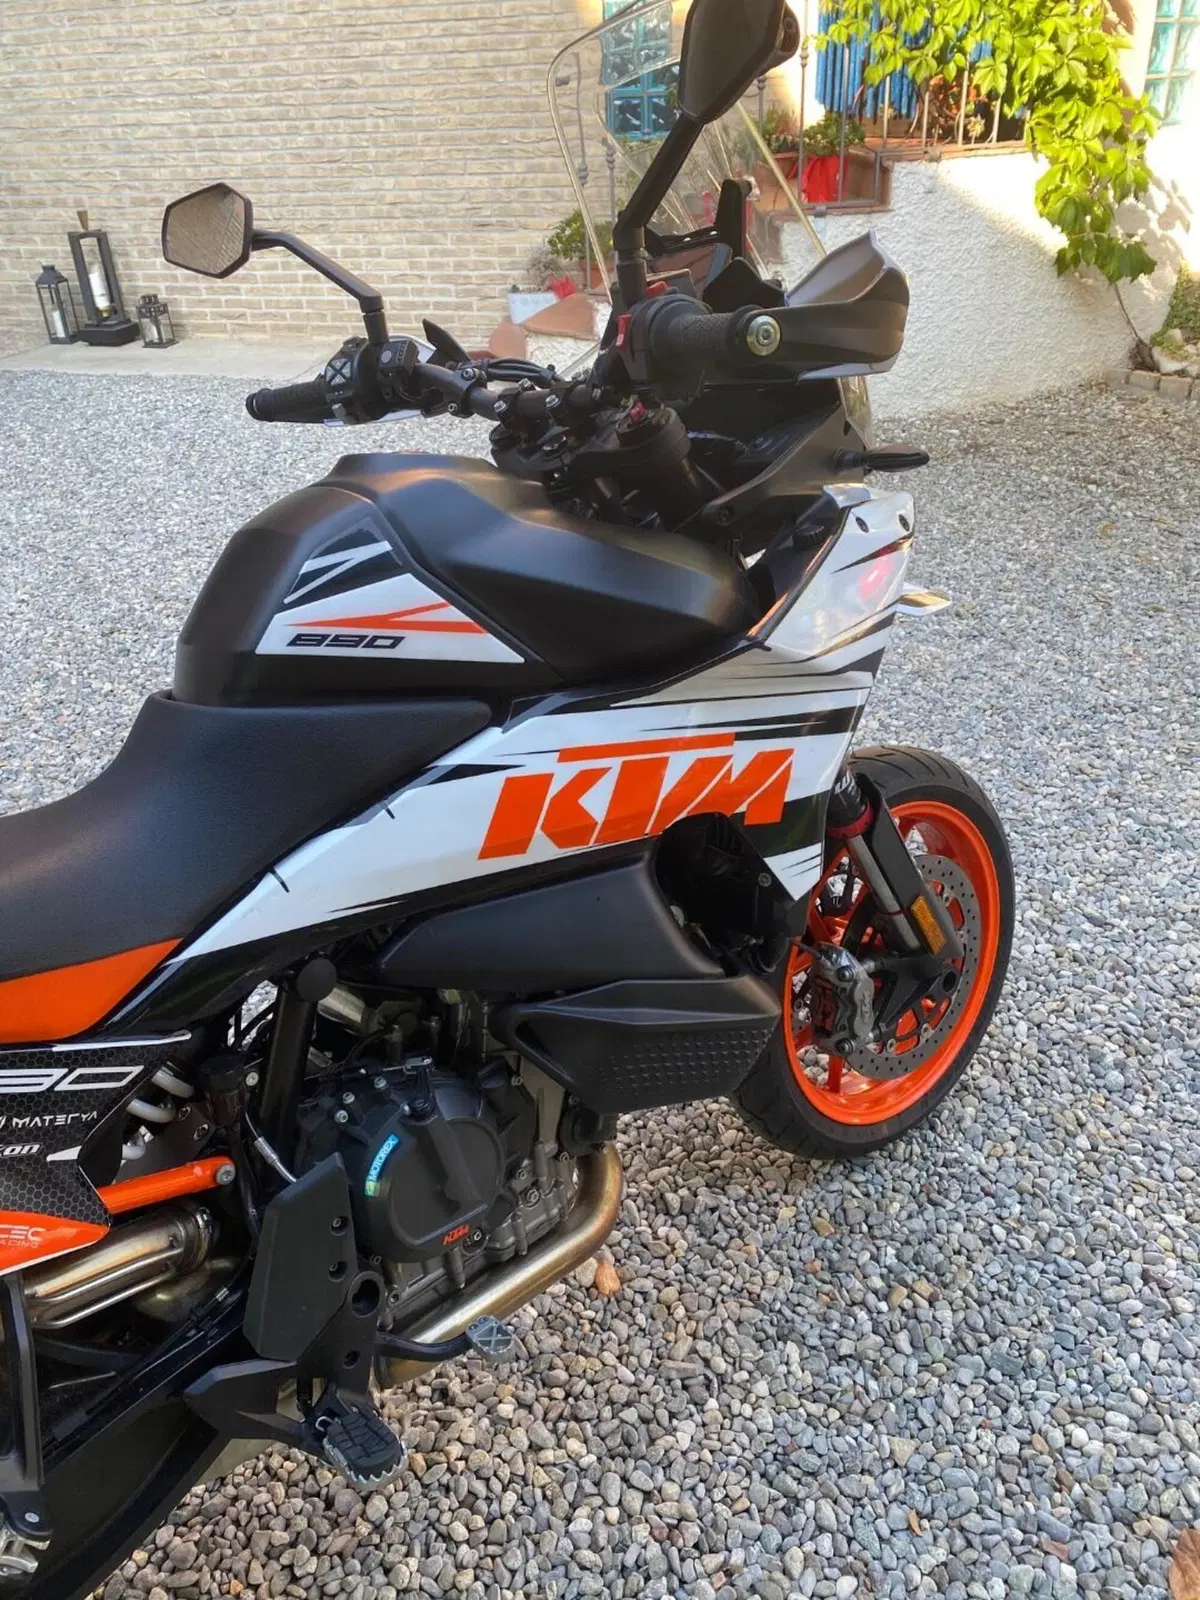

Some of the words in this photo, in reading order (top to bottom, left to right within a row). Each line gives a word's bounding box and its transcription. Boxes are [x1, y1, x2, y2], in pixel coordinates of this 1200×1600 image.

[286, 633, 406, 650] 890
[477, 732, 795, 860] KTM
[366, 1136, 396, 1181] MOTOREX
[442, 1224, 470, 1245] KTM
